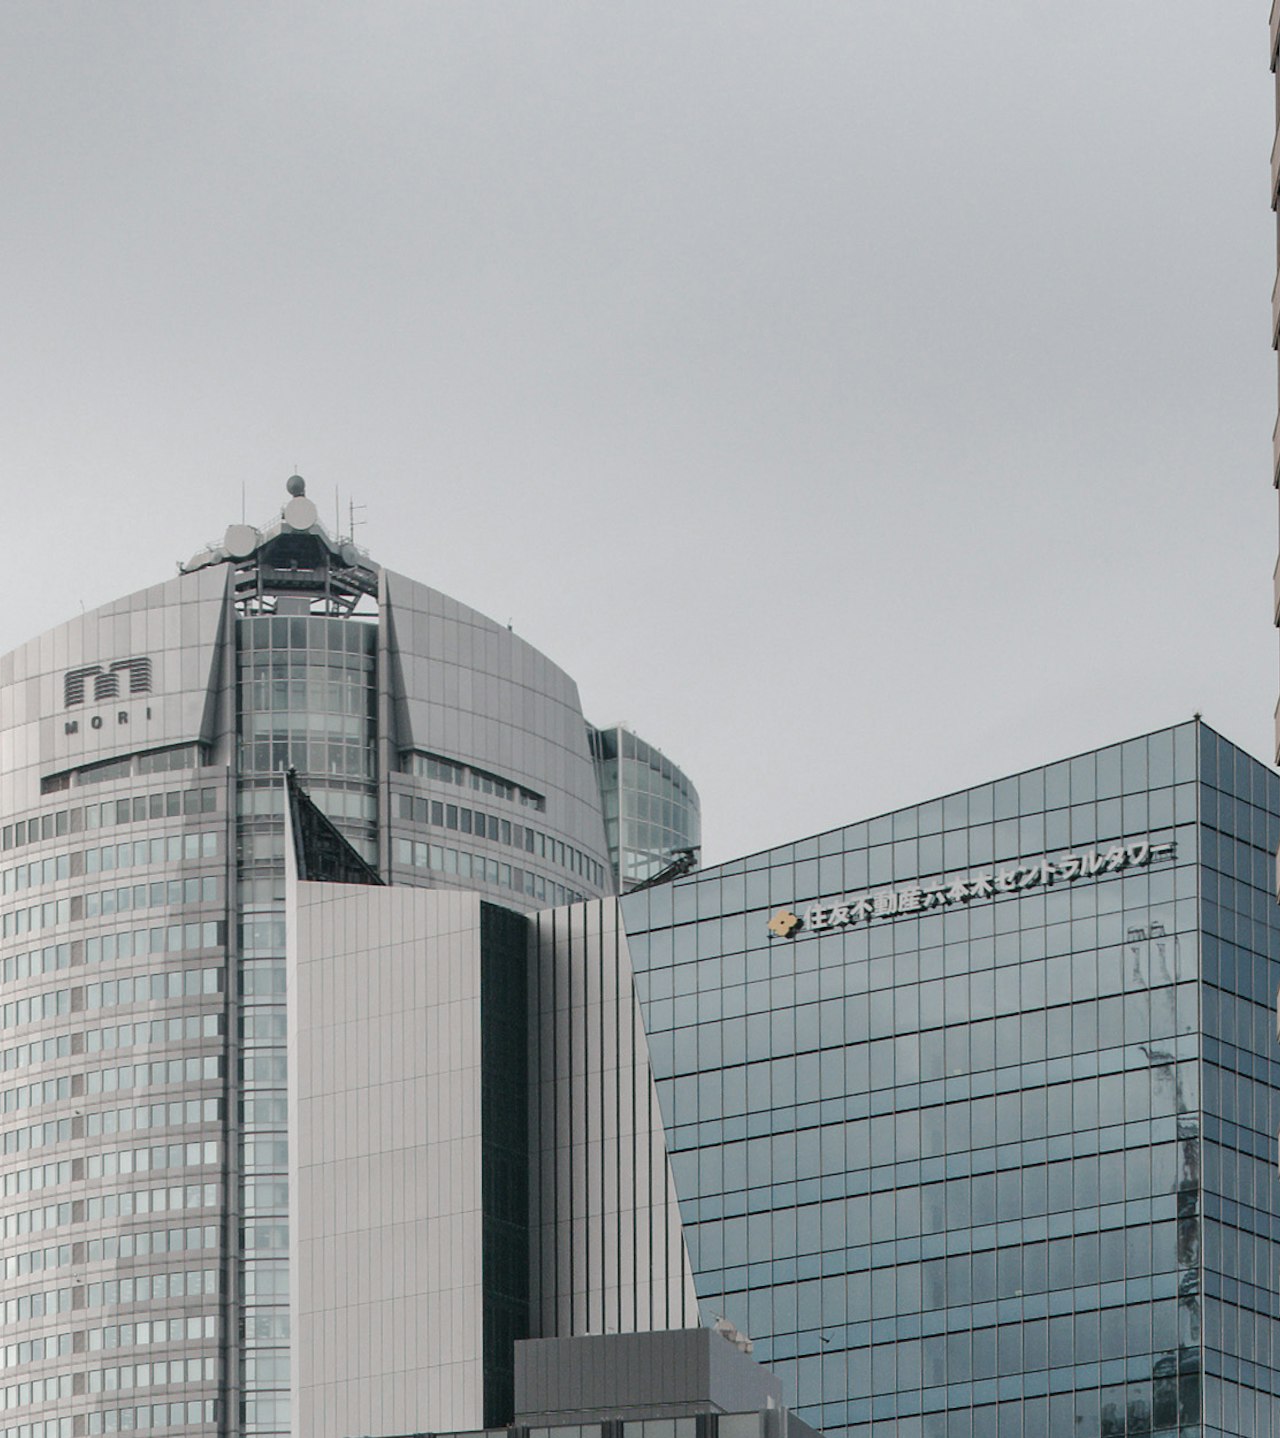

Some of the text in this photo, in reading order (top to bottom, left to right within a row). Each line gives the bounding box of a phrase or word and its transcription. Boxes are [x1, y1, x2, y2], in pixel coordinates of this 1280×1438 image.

[64, 706, 152, 735] MORI
[802, 840, 1177, 931] 住友不動産六本木セントラルタワー
